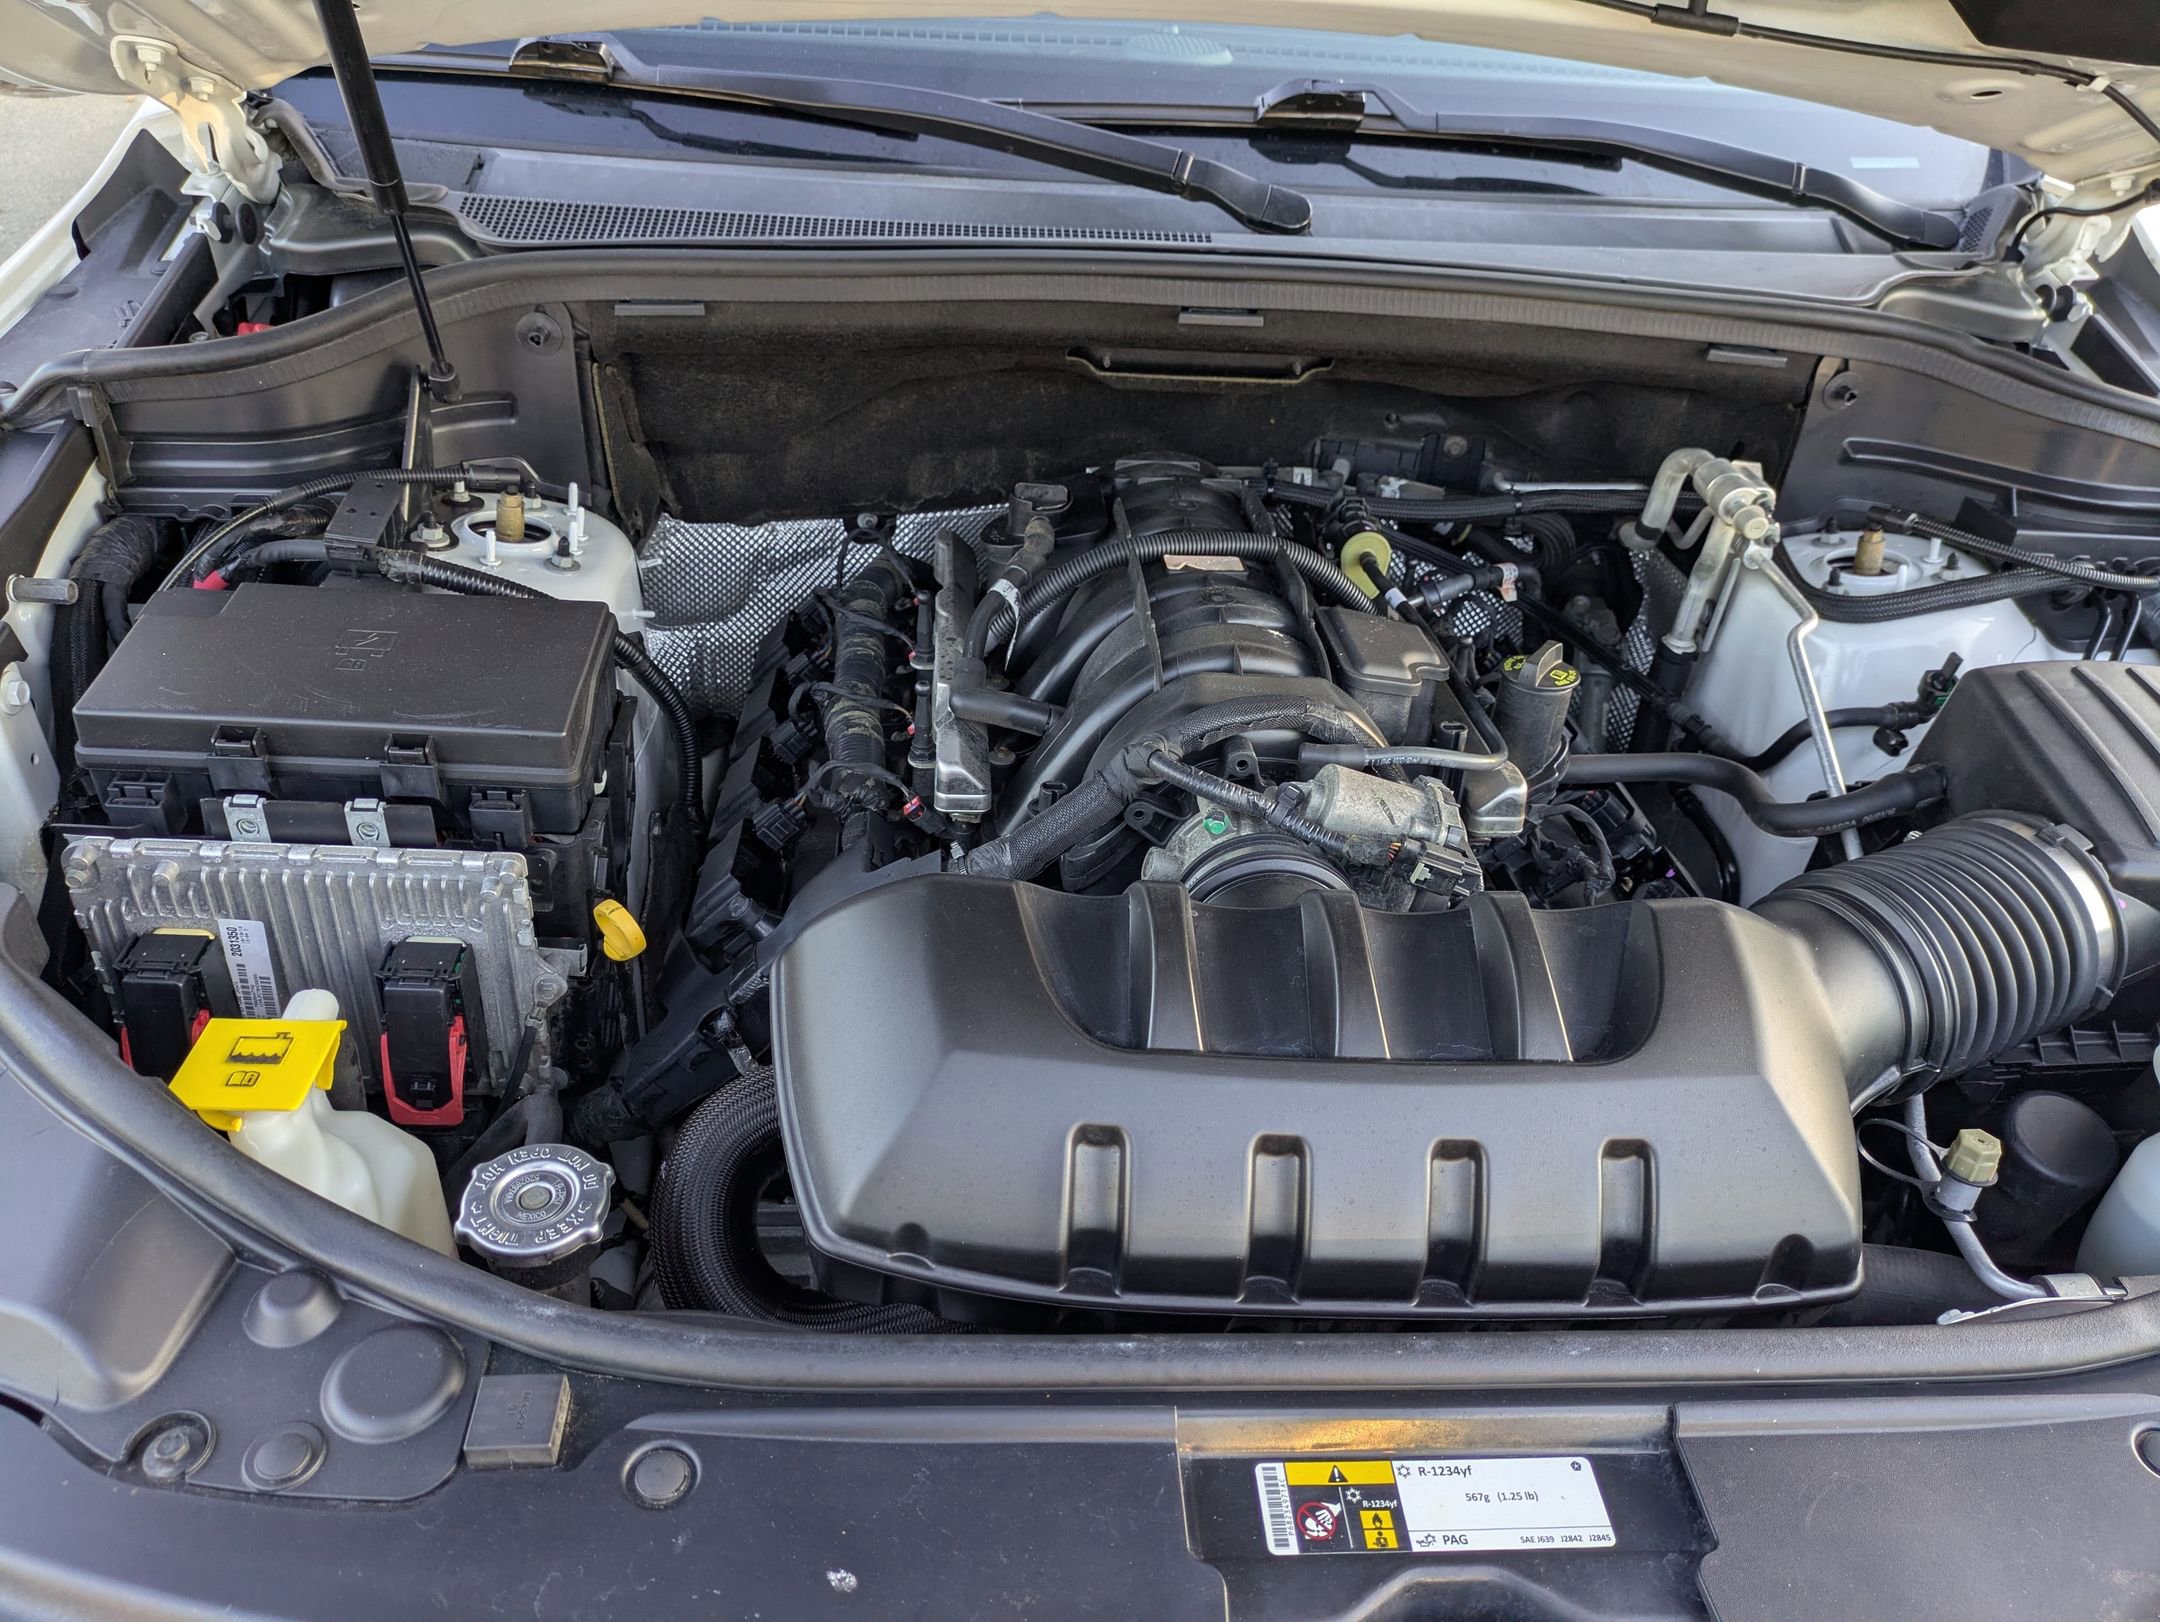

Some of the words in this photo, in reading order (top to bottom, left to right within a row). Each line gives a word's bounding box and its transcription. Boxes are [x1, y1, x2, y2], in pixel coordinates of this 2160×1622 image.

[226, 926, 243, 957] 2031350
[508, 1147, 551, 1165] OPEN
[557, 1150, 591, 1171] NOT
[475, 1162, 506, 1191] HOT
[582, 1174, 599, 1190] DO
[516, 1210, 547, 1221] MEXICO
[470, 1216, 519, 1246] TIGHT
[535, 1213, 585, 1244] KEEP
[1417, 1464, 1473, 1477] R-1234yf
[1362, 1499, 1398, 1509] R-1234yf
[1465, 1492, 1490, 1503] 567g
[1497, 1491, 1522, 1503] (1.25
[1524, 1490, 1539, 1502] lb)
[1278, 1477, 1295, 1536] P68234971AC
[1442, 1534, 1469, 1545] PAG
[1520, 1535, 1536, 1544] SAE
[1537, 1535, 1555, 1543] J639
[1560, 1534, 1583, 1543] J2842
[1589, 1533, 1612, 1542] J2845
